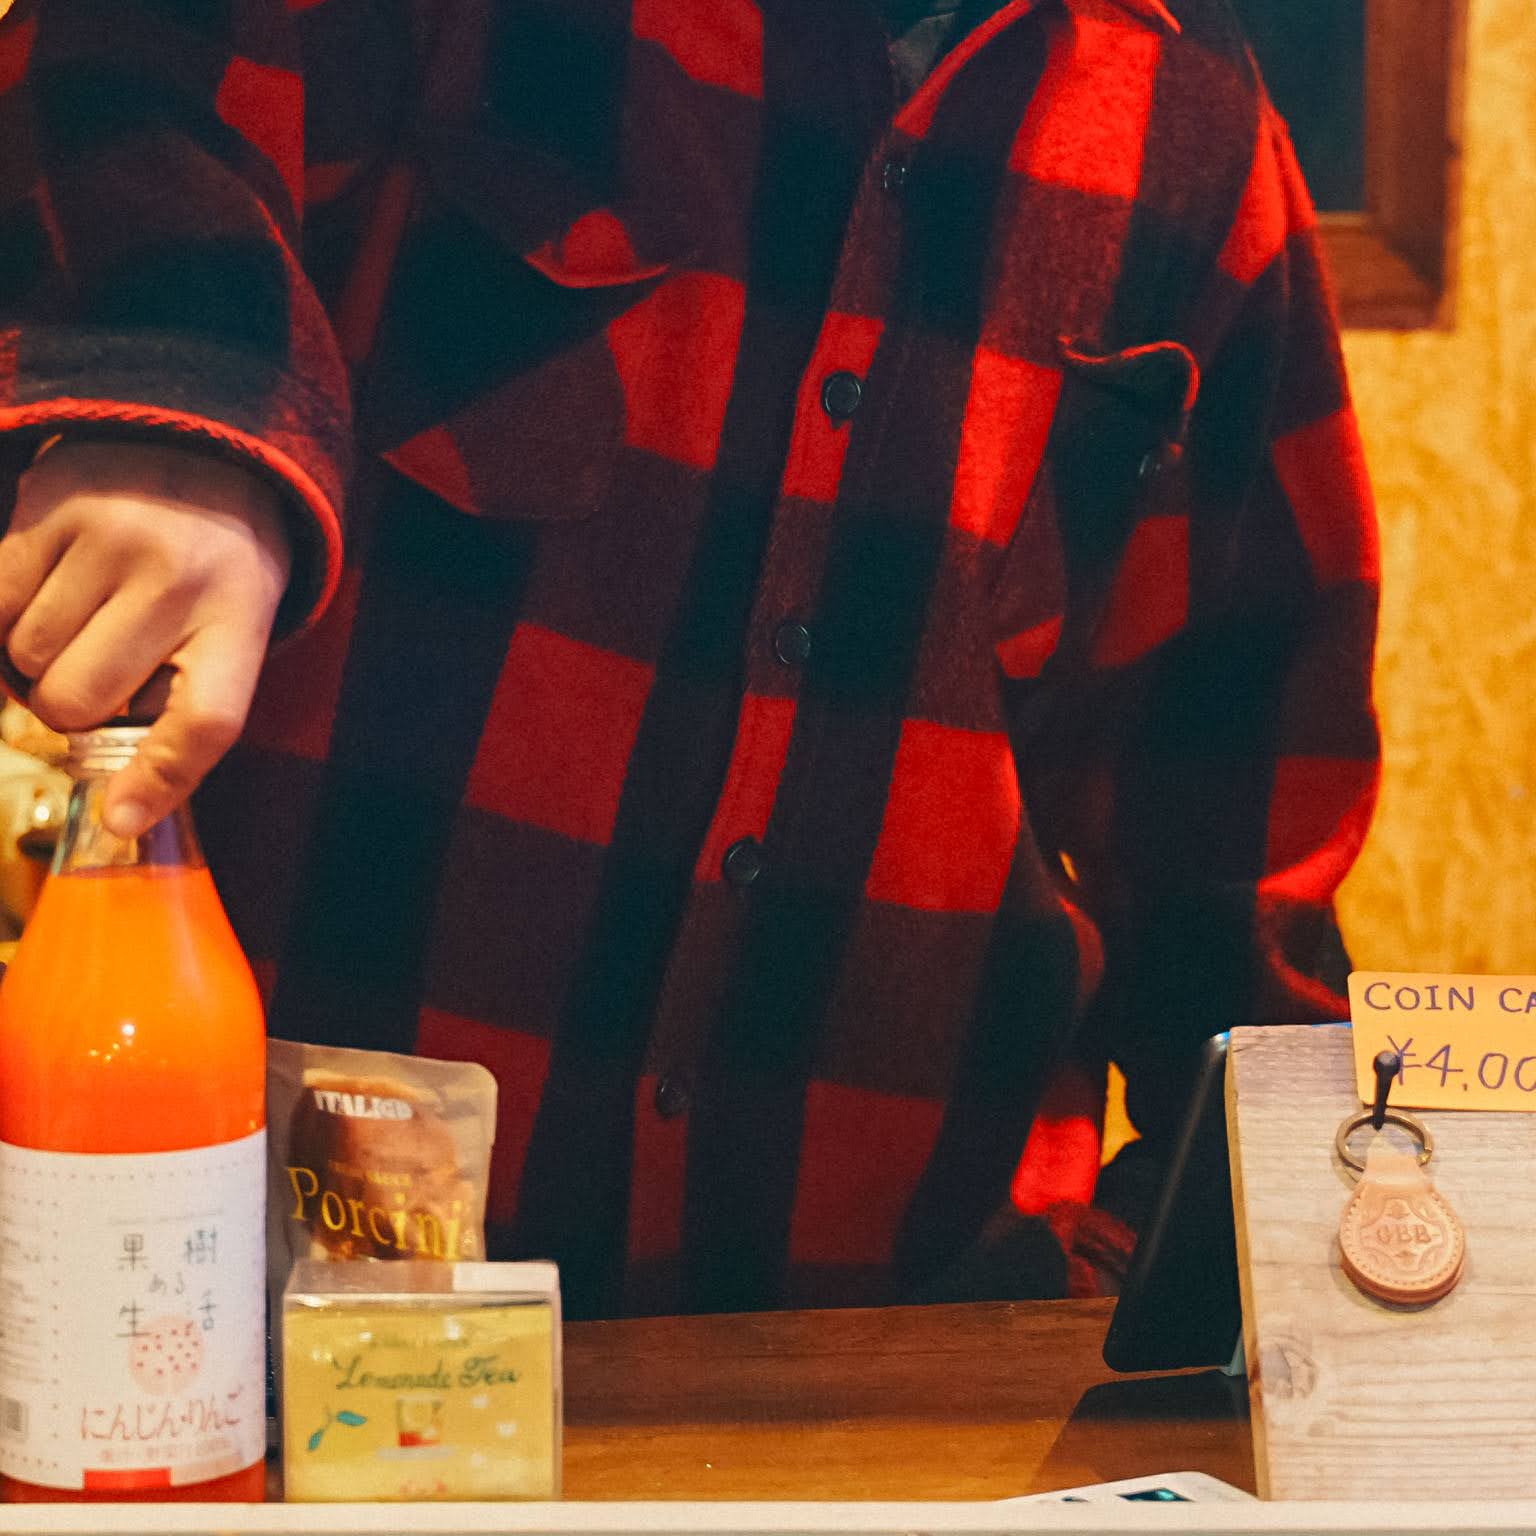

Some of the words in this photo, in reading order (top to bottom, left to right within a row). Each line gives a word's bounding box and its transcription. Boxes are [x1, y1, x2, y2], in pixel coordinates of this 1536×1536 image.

[1364, 982, 1475, 1011] COIN
[286, 1166, 463, 1261] Porcini
[458, 1353, 522, 1387] Tea
